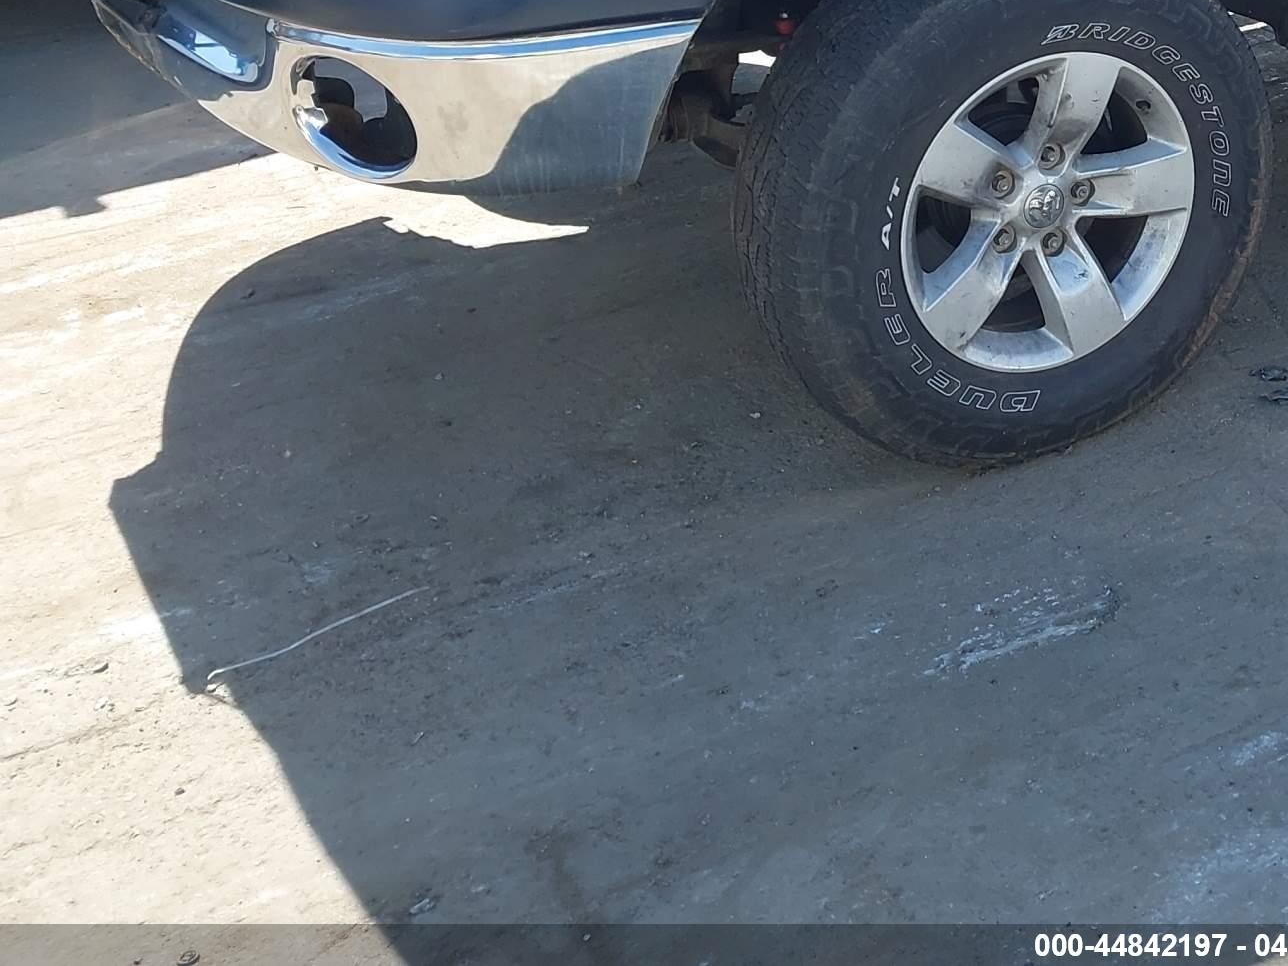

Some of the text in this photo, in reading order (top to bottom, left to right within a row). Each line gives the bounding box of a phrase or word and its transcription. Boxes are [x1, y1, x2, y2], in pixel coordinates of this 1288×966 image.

[1041, 22, 1232, 217] BRIDGESTONE
[876, 177, 1041, 412] DUELER A/T
